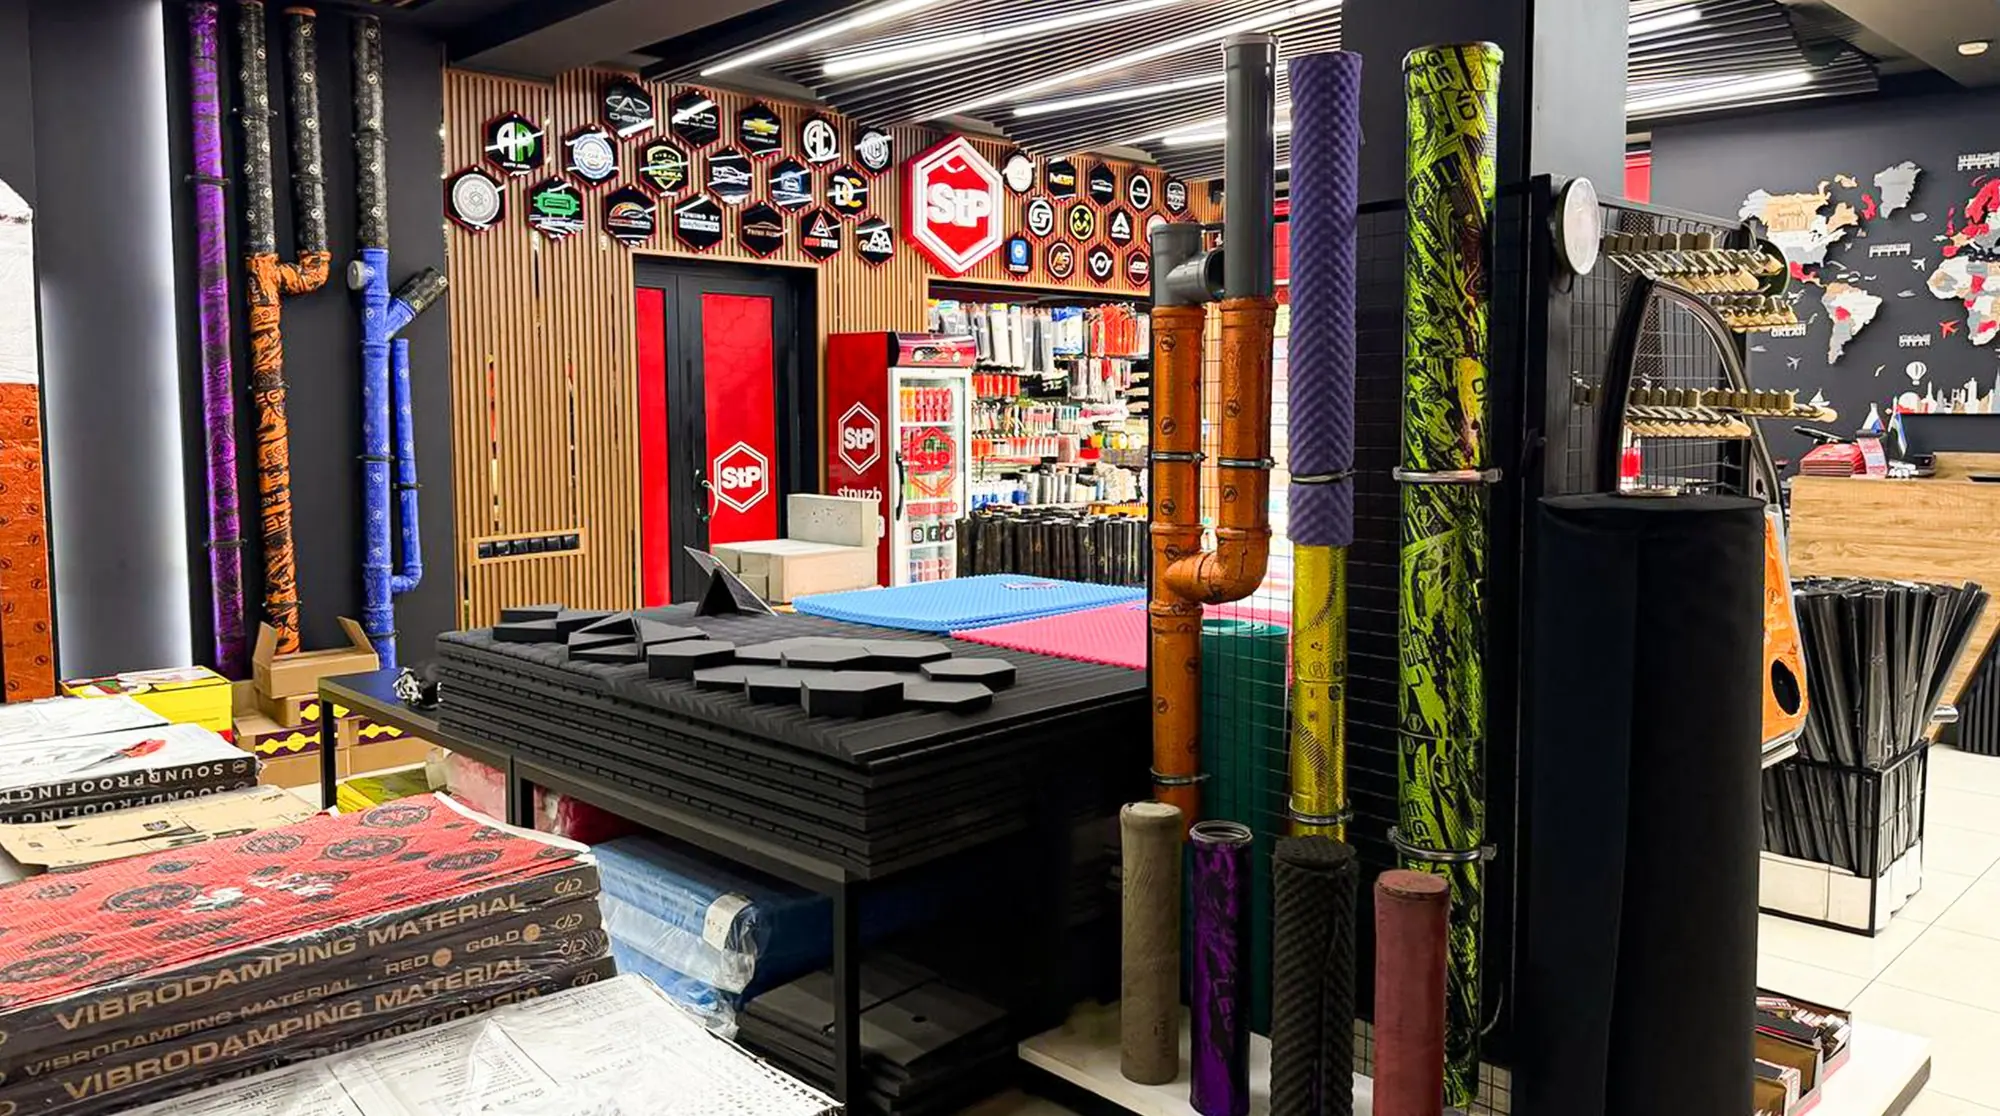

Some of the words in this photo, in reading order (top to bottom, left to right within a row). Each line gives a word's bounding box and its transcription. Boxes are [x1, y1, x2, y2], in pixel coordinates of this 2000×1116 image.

[927, 183, 992, 227] StP
[844, 427, 875, 450] StP
[721, 466, 761, 489] StP
[18, 764, 224, 802] SOUNDPROOFING
[55, 936, 356, 1031] VIBRODAMPING
[368, 894, 527, 947] MATERIAL
[25, 1011, 233, 1077] VIBRODAMPING
[241, 978, 358, 1019] MATERIAL
[385, 954, 429, 976] RED
[465, 929, 520, 953] GOLD
[64, 1001, 363, 1101] VIBRODAMPING
[375, 956, 530, 1014] MATERIAL
